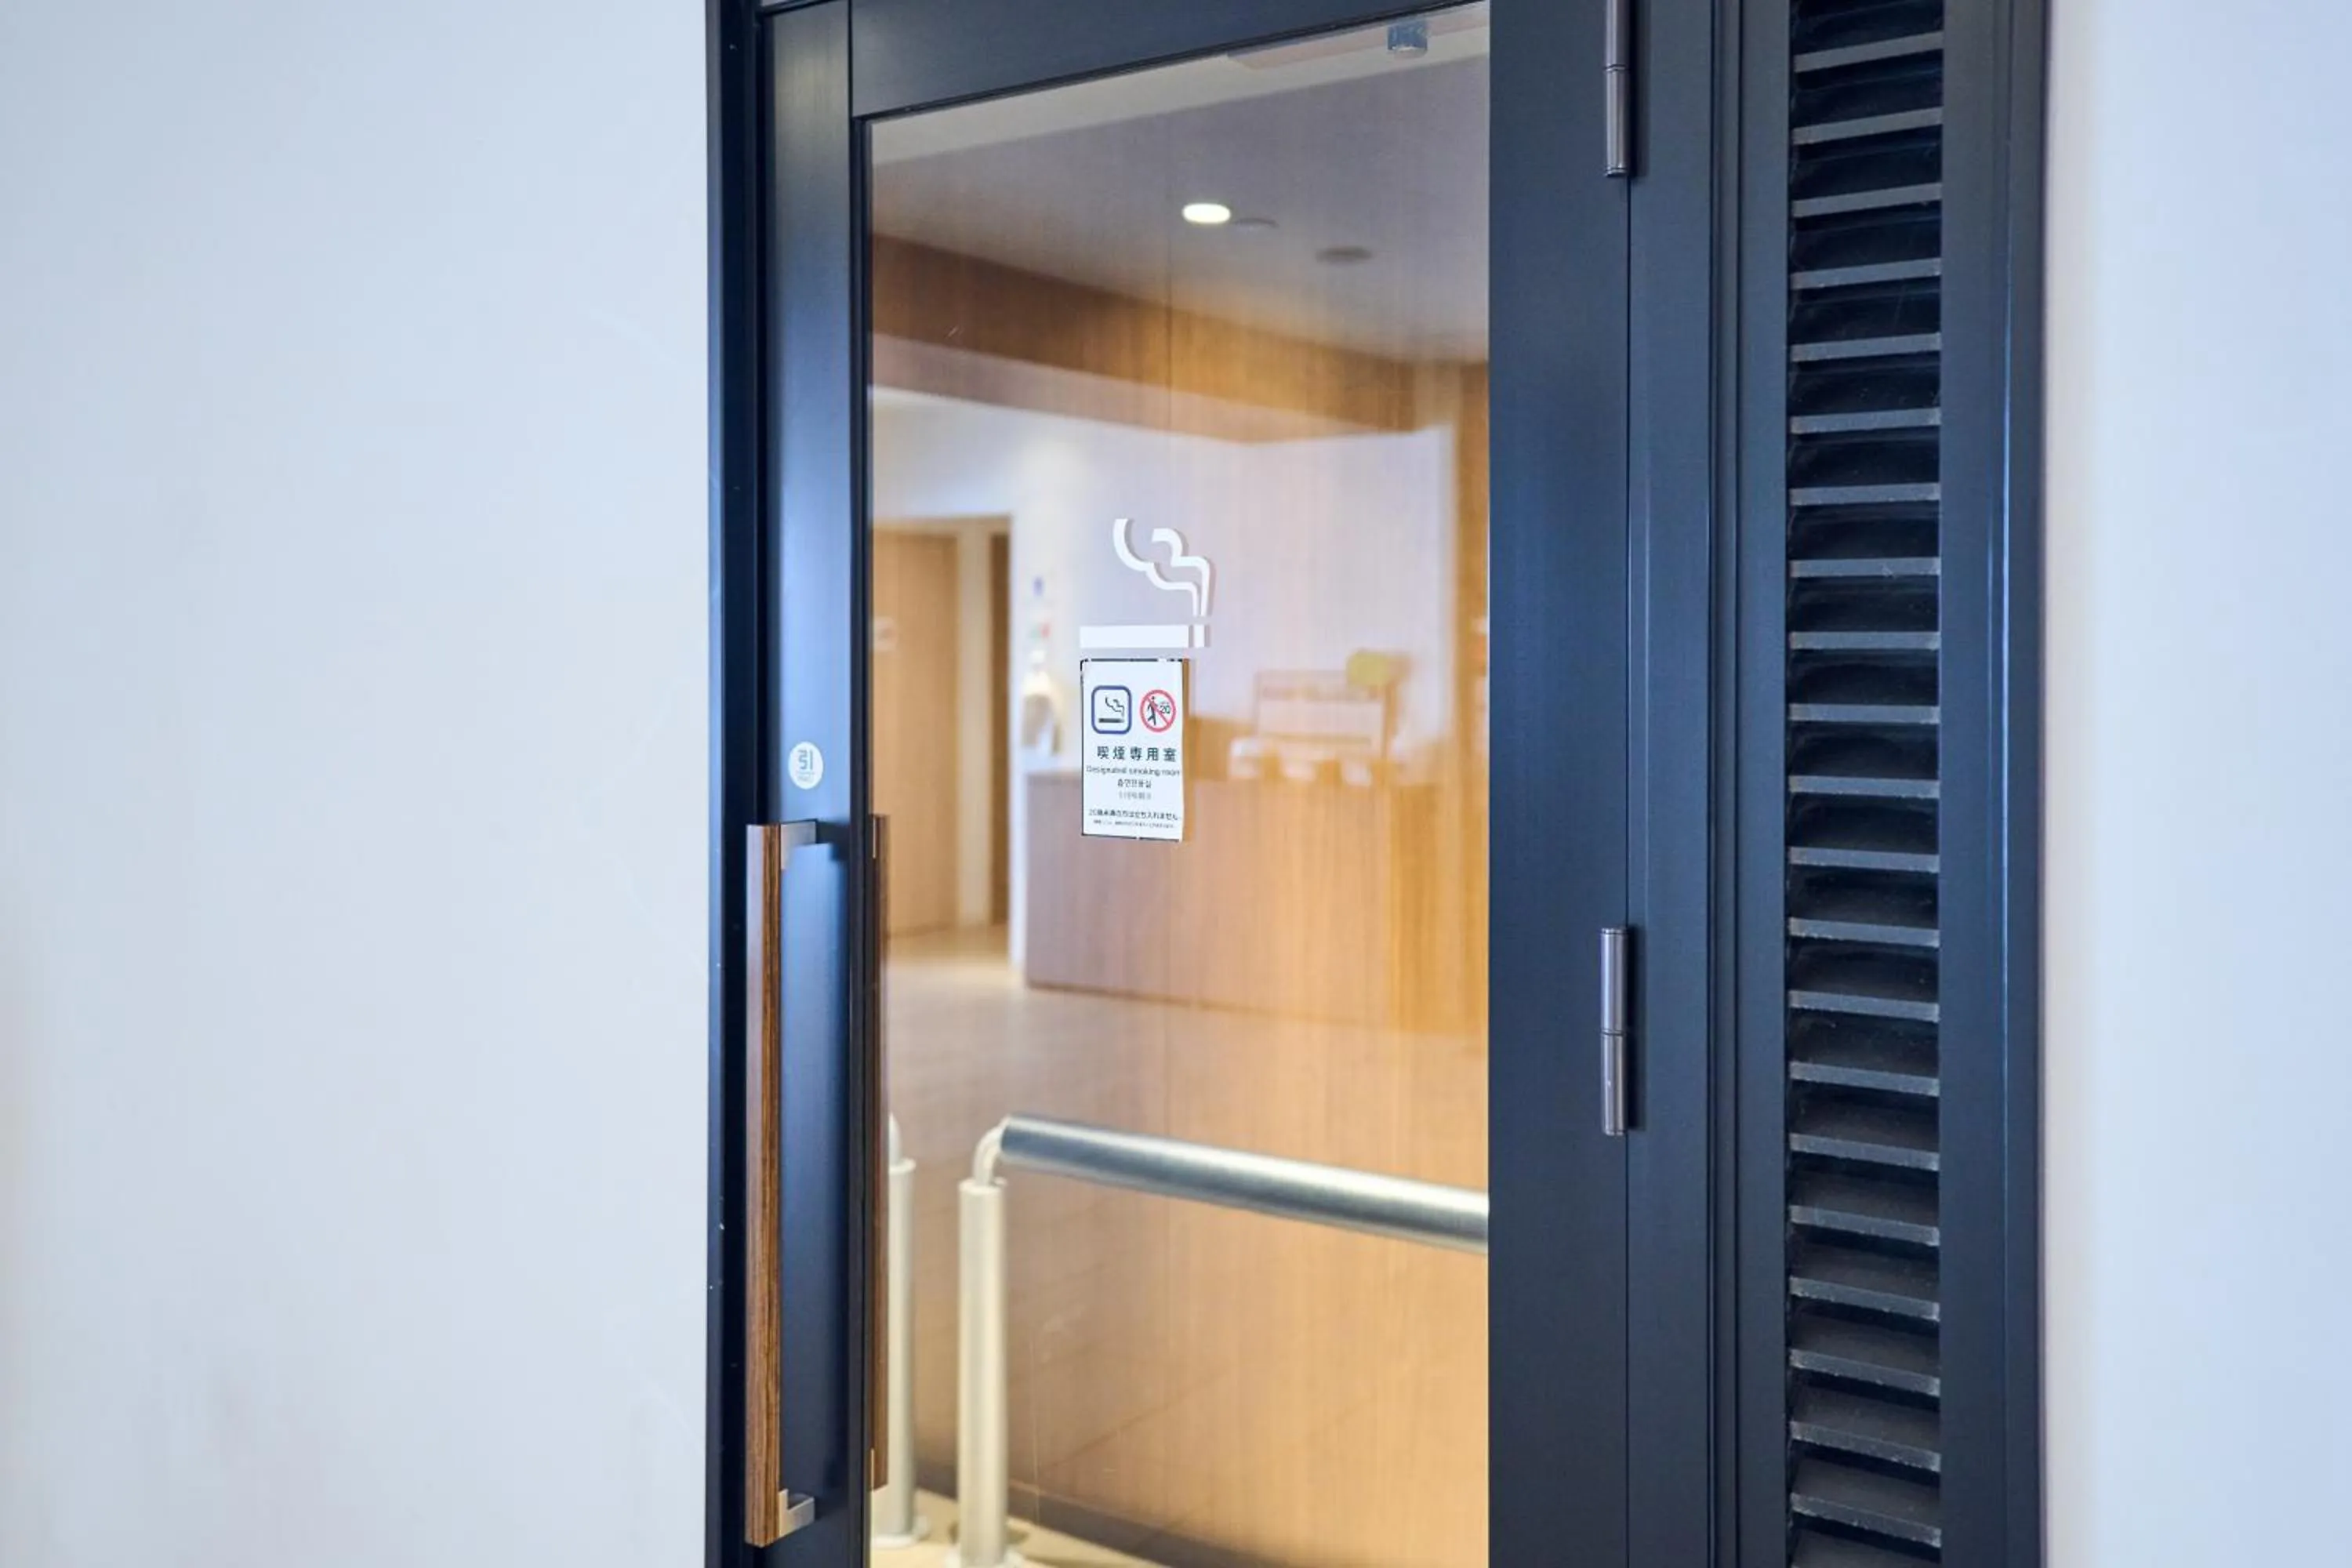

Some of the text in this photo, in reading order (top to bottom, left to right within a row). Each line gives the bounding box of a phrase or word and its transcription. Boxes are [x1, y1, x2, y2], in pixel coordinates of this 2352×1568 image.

[1097, 746, 1177, 763] 喫煙専用室
[1129, 768, 1160, 776] smoking
